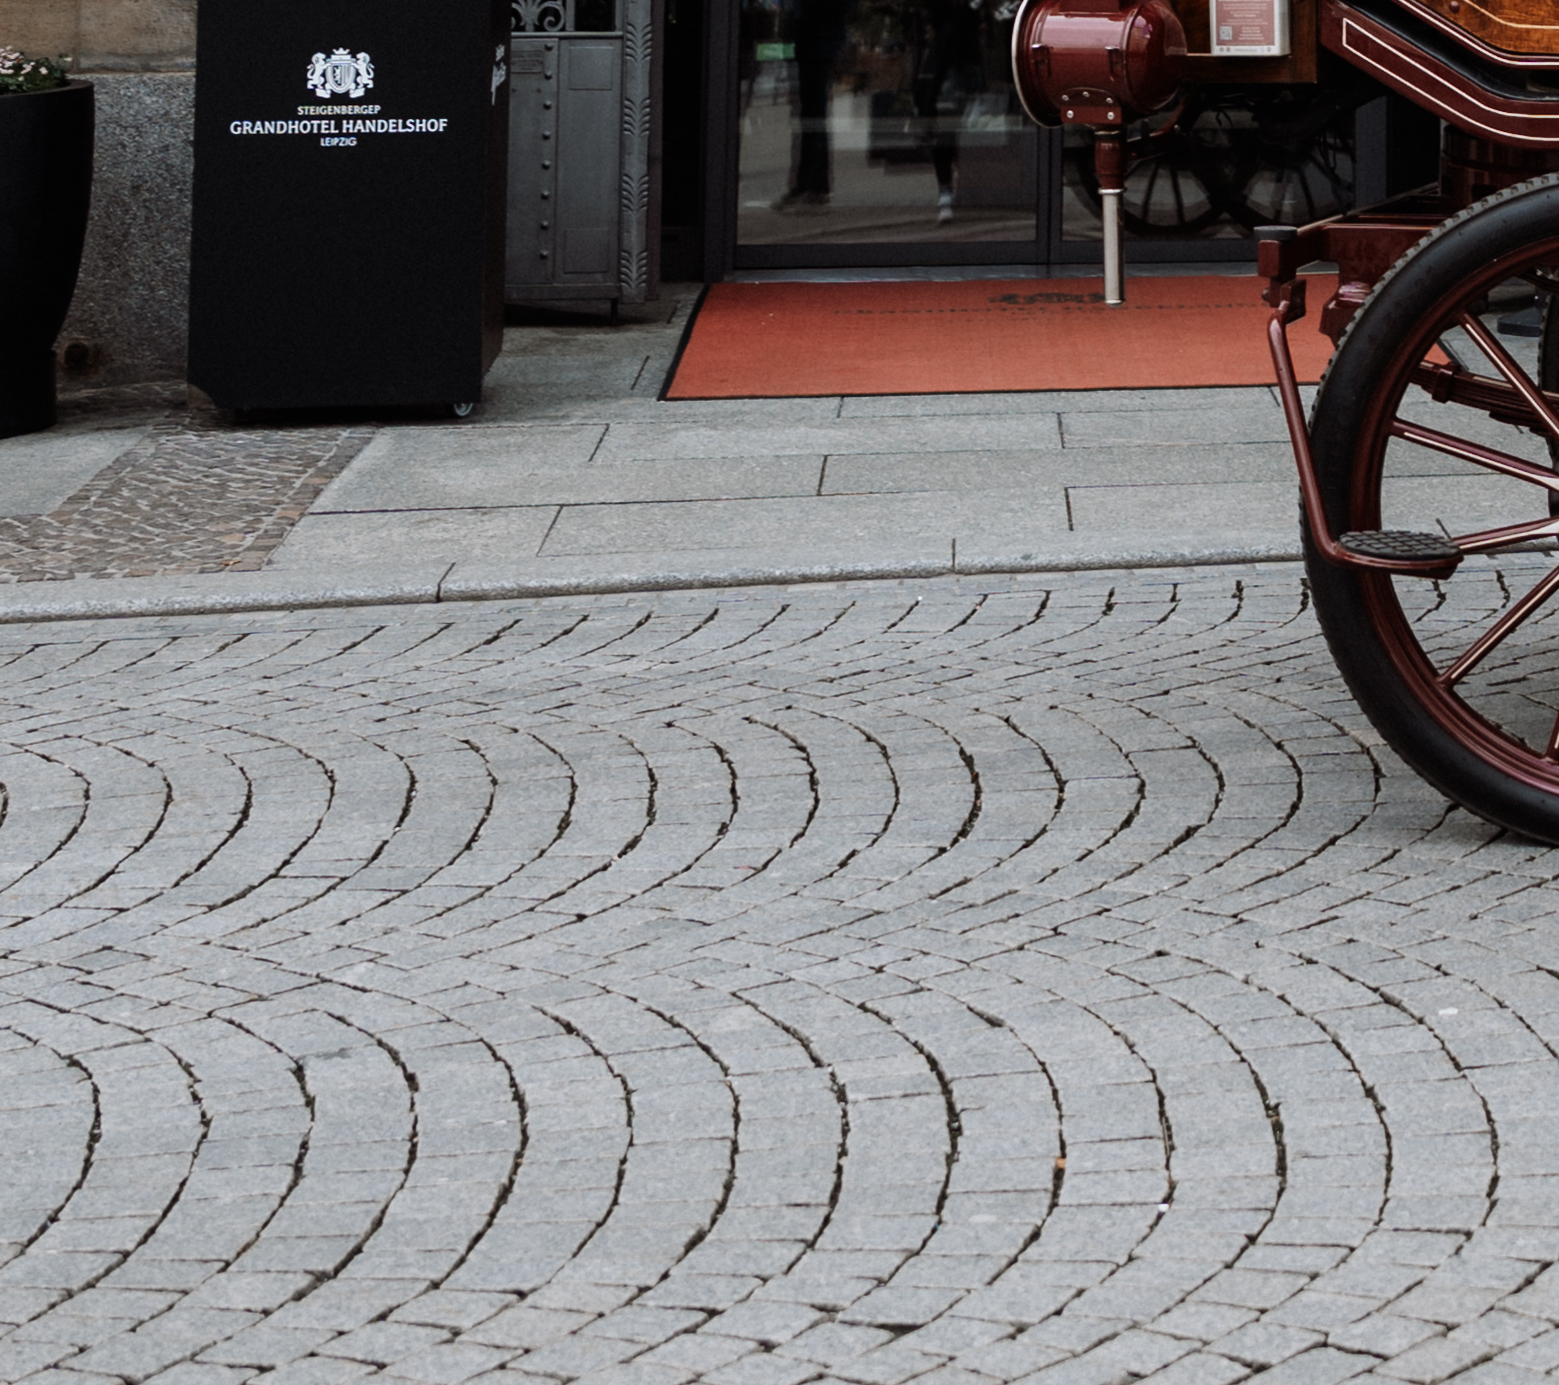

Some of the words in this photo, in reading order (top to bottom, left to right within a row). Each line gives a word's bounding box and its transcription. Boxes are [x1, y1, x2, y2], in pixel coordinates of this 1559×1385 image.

[230, 120, 339, 134] GRANDHOTEL
[342, 118, 448, 133] HANDELSHOF
[320, 136, 358, 147] LEIPZIG
